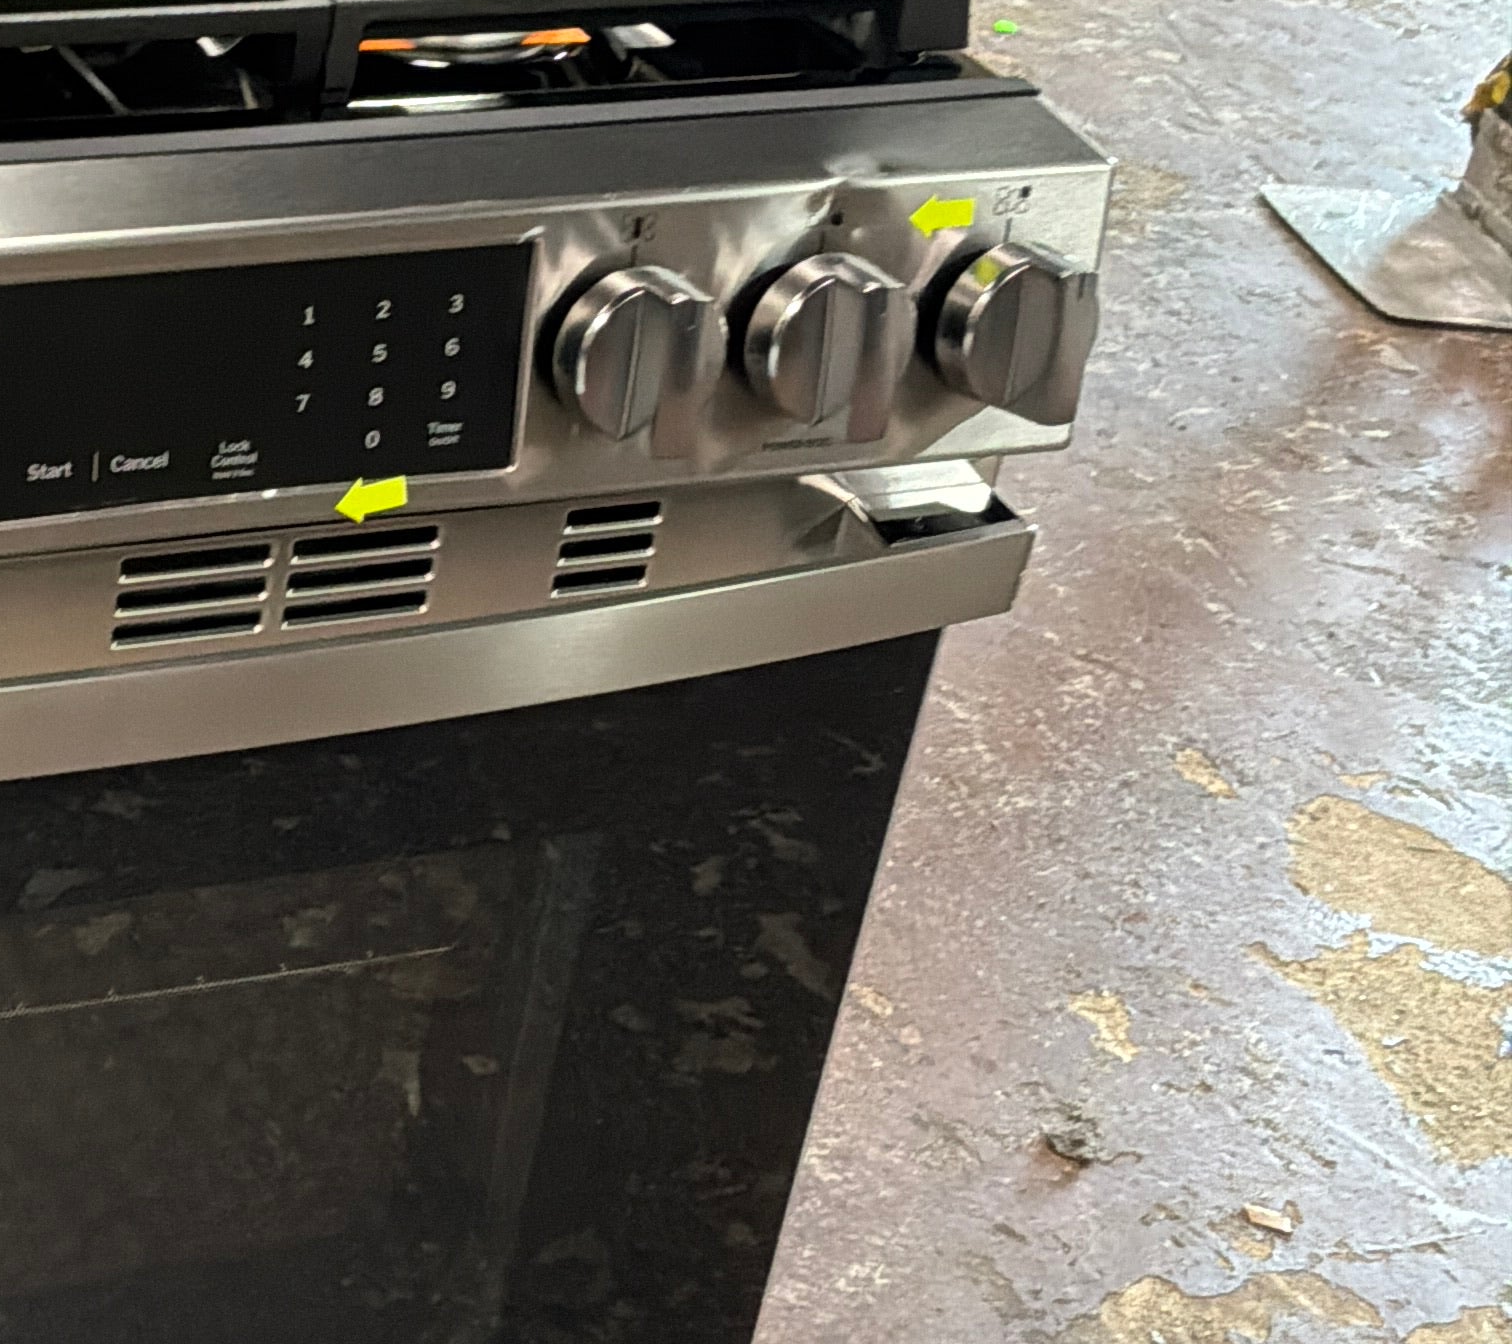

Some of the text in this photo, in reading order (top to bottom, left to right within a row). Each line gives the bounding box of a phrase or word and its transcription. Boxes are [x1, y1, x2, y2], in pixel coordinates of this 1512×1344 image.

[376, 300, 391, 319] 2
[449, 294, 463, 313] 3
[304, 306, 314, 325] 1
[372, 344, 387, 363] 5
[445, 338, 460, 356] 6
[298, 351, 313, 368] 4
[368, 388, 383, 406] 8
[441, 381, 456, 399] 9
[296, 394, 310, 412] 7
[365, 430, 380, 448] 0
[110, 450, 170, 473] Cancel
[26, 462, 74, 482] Start
